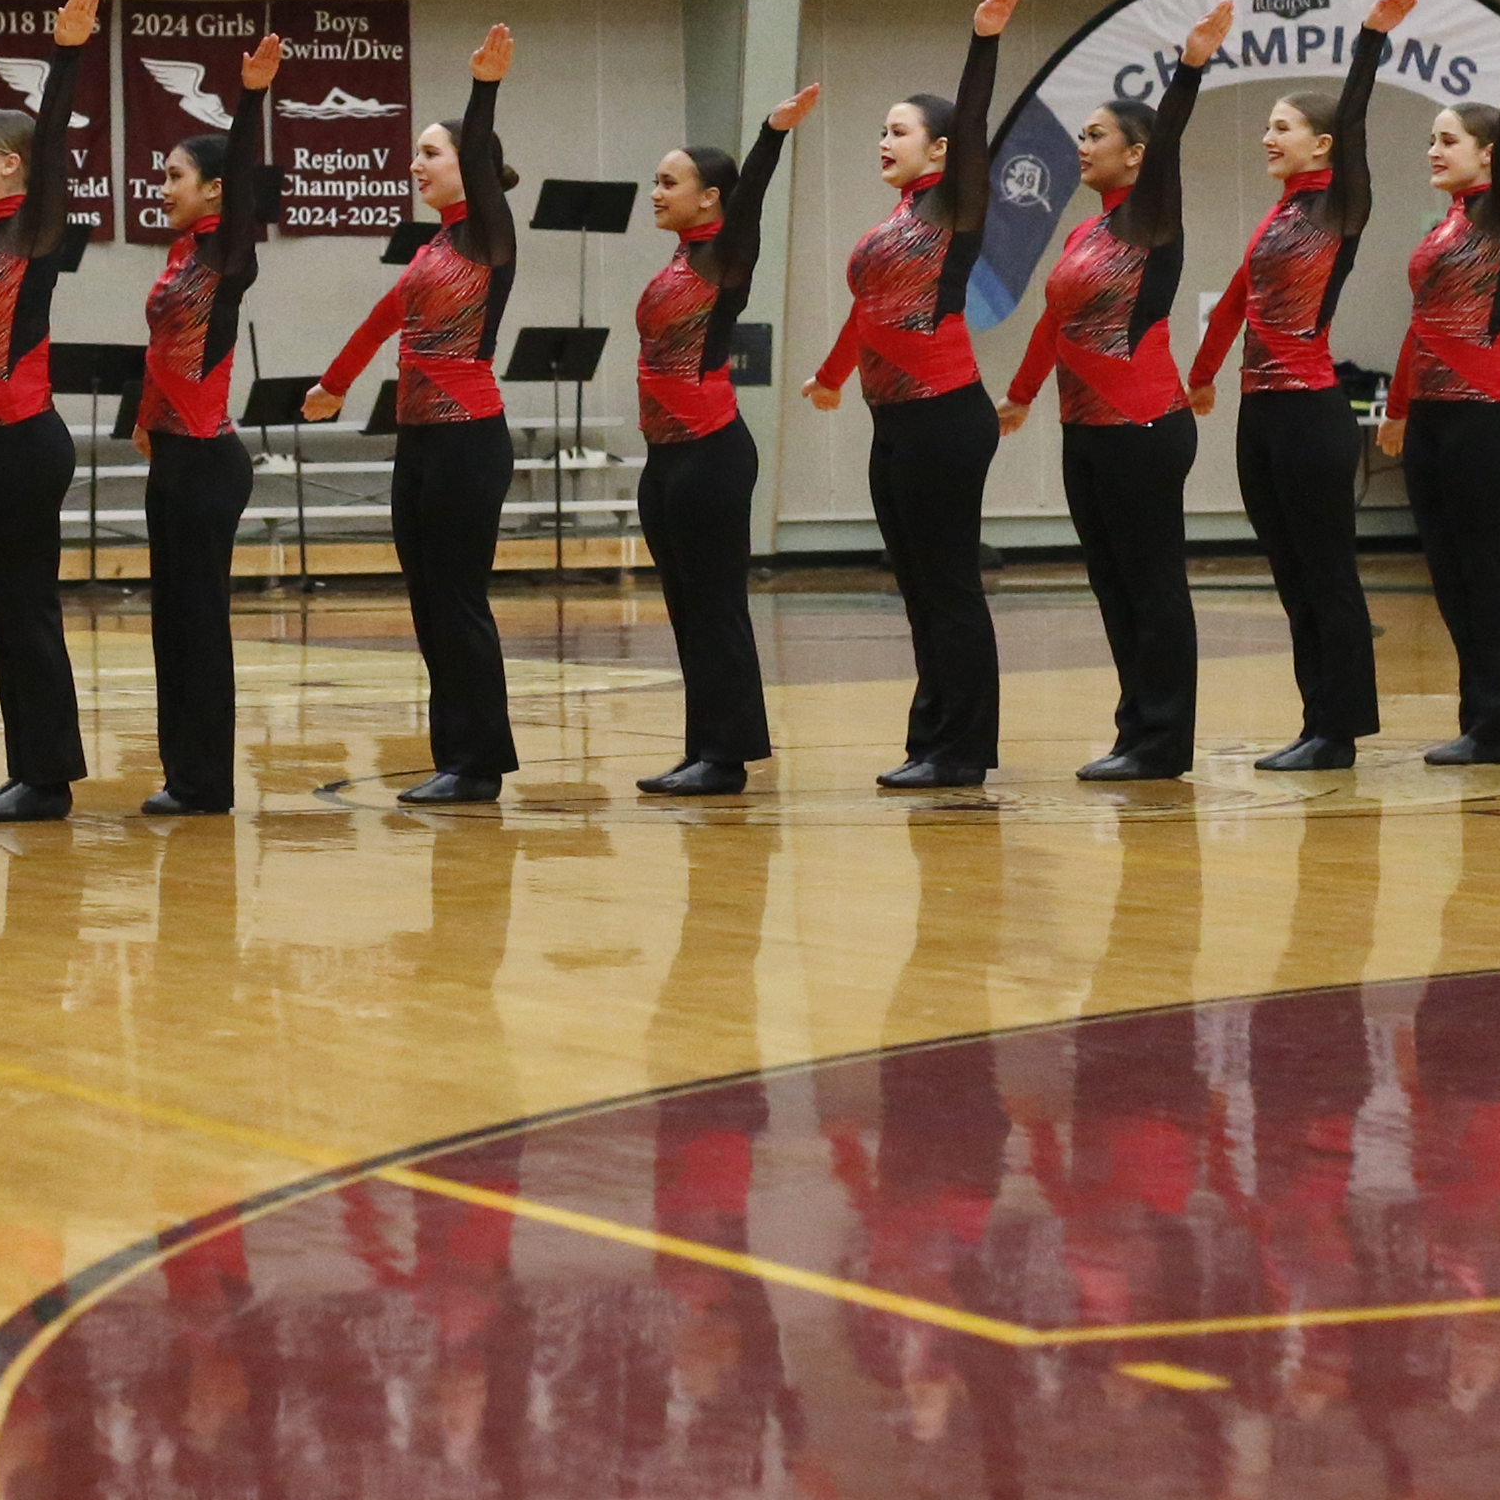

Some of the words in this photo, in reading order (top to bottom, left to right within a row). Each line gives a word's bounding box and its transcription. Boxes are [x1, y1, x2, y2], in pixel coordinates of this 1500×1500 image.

[132, 14, 188, 37] 2024
[195, 14, 255, 37] Girls
[315, 10, 369, 37] Boys
